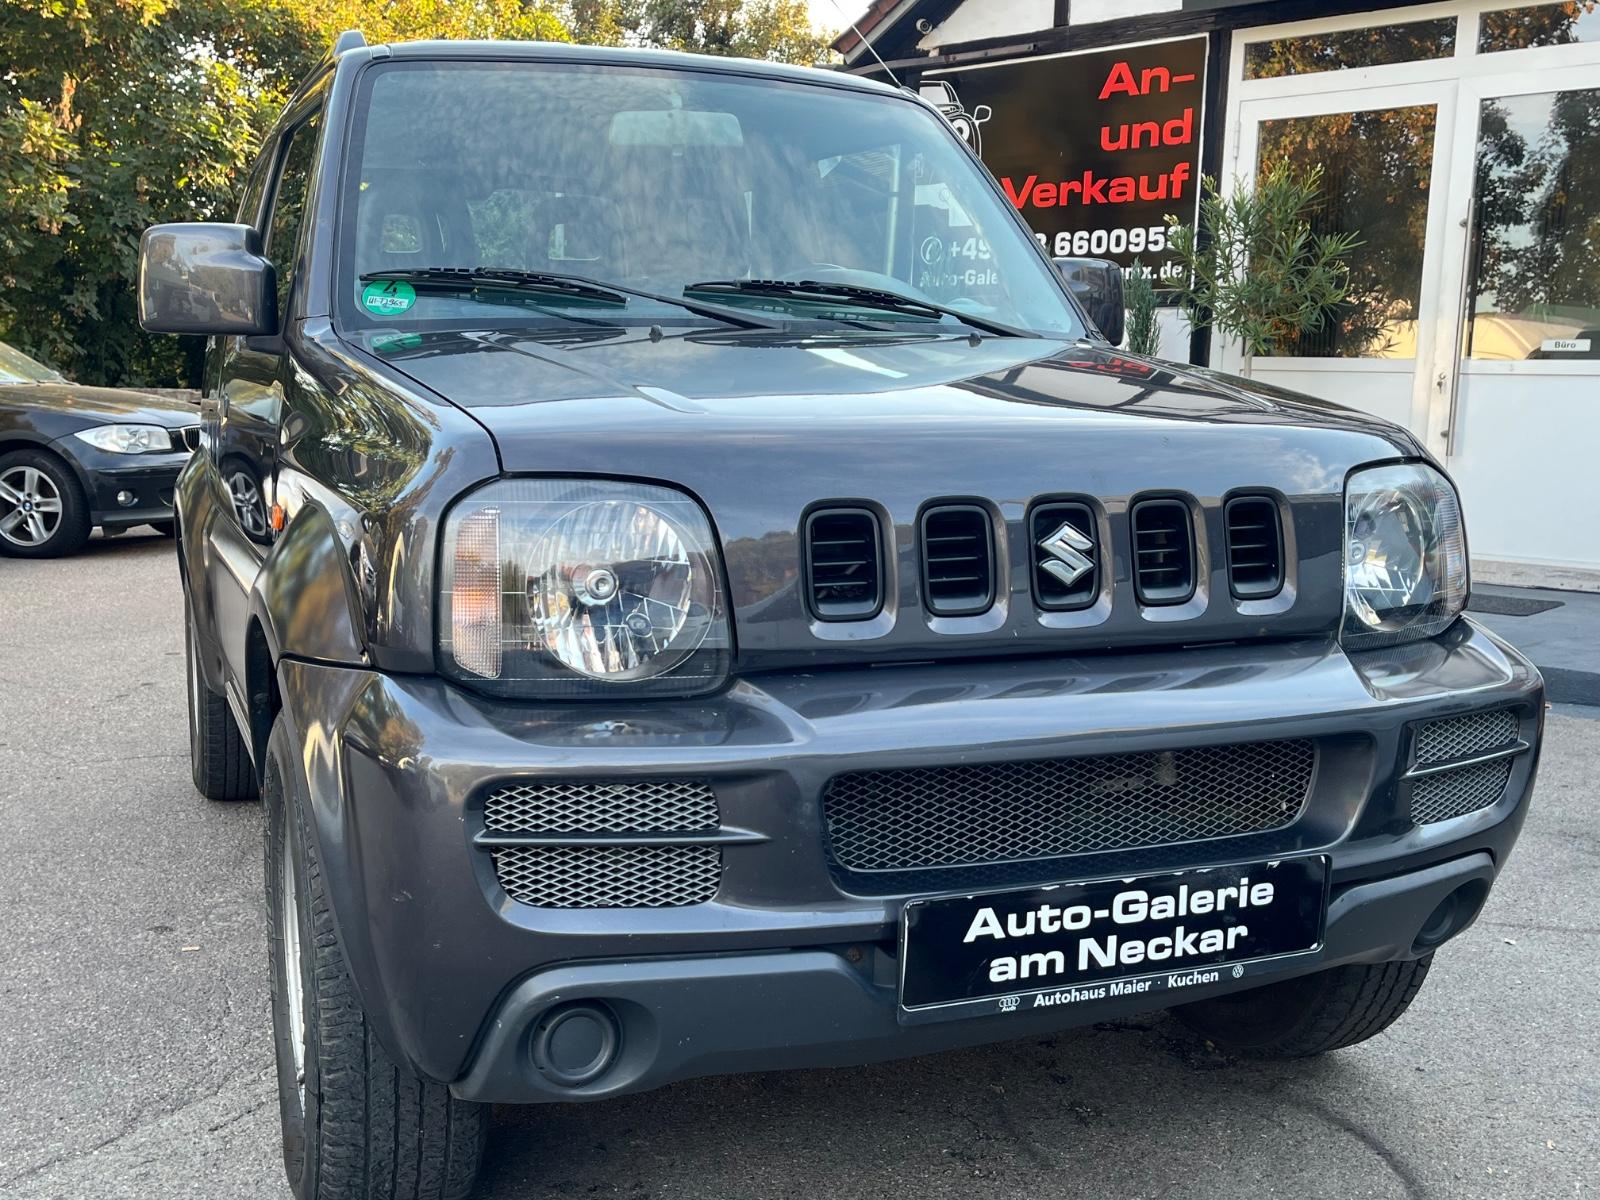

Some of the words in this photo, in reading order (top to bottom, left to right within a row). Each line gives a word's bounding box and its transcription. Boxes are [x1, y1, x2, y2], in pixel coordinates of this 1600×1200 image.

[1098, 62, 1195, 100] An-
[1100, 108, 1193, 151] und
[1001, 163, 1190, 210] Verkauf
[1554, 341, 1577, 349] Büro
[962, 878, 1275, 943] Auto-Galerie
[988, 951, 1065, 983] am
[1078, 925, 1249, 971] Neckar
[1033, 986, 1106, 1008] Autohaus
[1109, 979, 1152, 997] Maier
[1167, 969, 1219, 988] Kuchen
